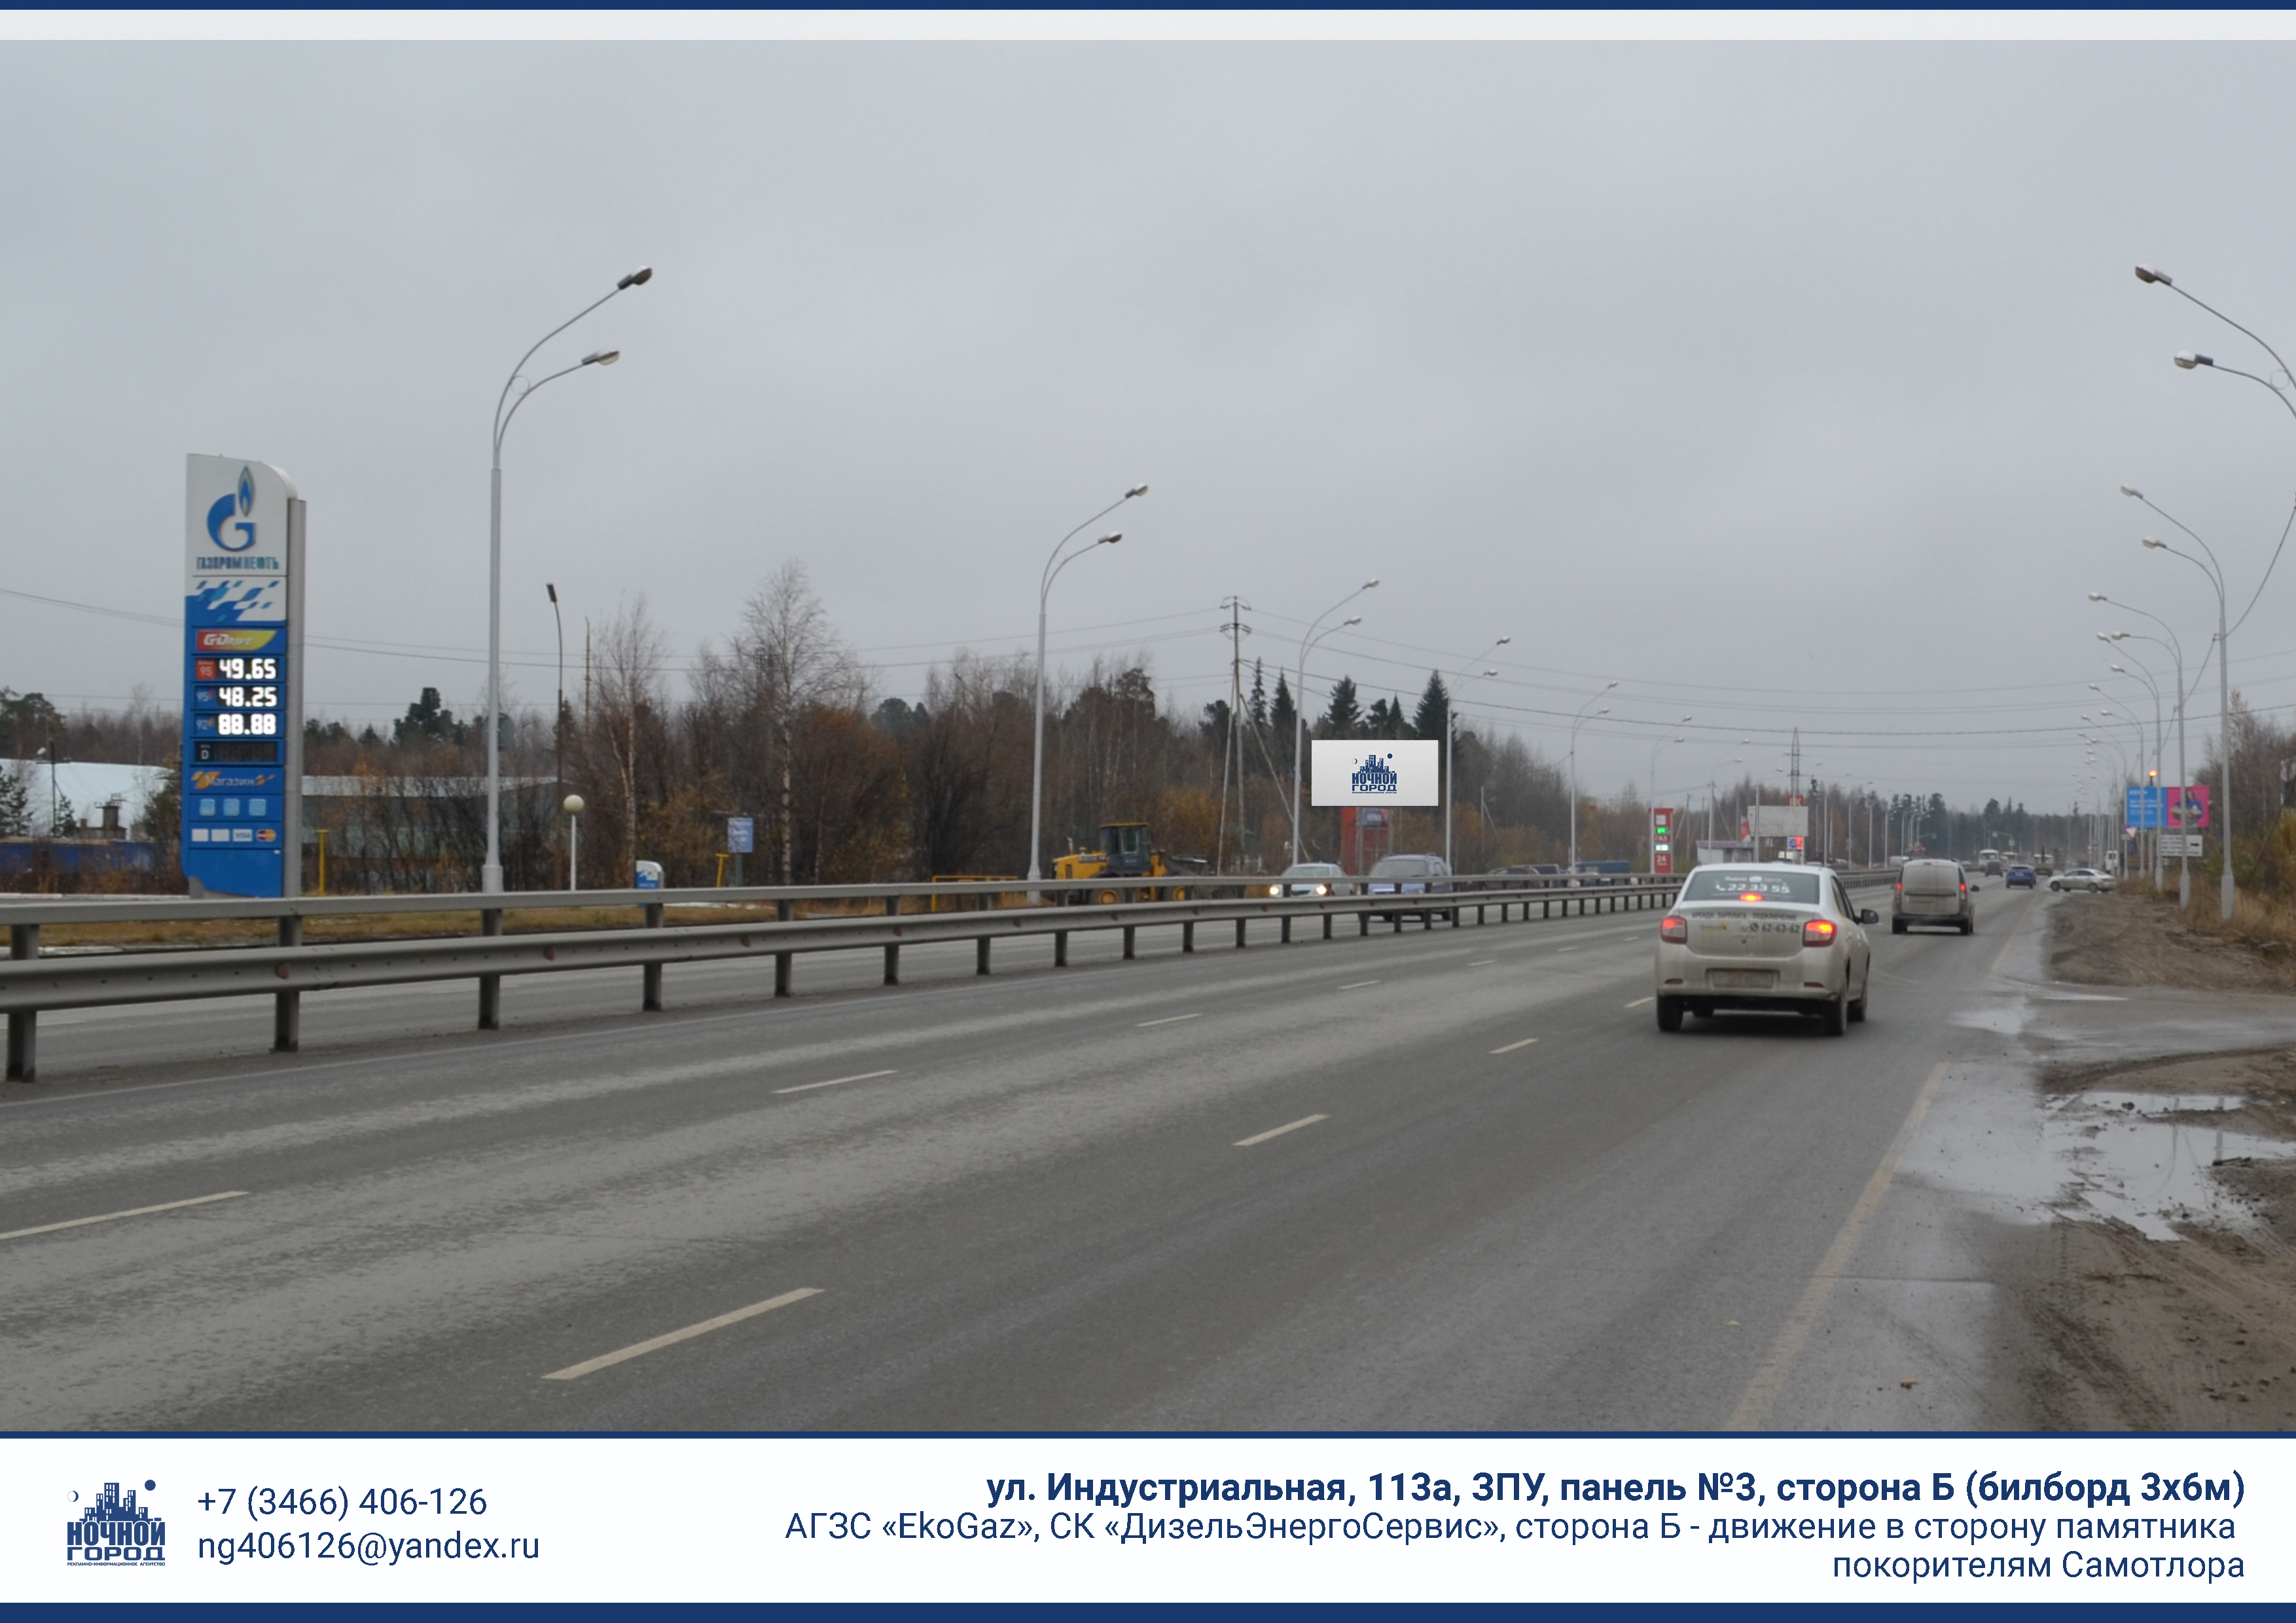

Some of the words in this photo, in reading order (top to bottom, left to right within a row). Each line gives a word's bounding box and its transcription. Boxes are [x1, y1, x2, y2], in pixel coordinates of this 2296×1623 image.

[196, 556, 279, 569] ГАЗПРОМНЕФТЬ
[200, 666, 212, 677] 95
[219, 658, 276, 679] 49.65
[219, 687, 278, 707] 48.25
[218, 713, 276, 735] 88.88
[206, 776, 255, 787] Магазин
[1352, 771, 1397, 785] НОЧНОЙ
